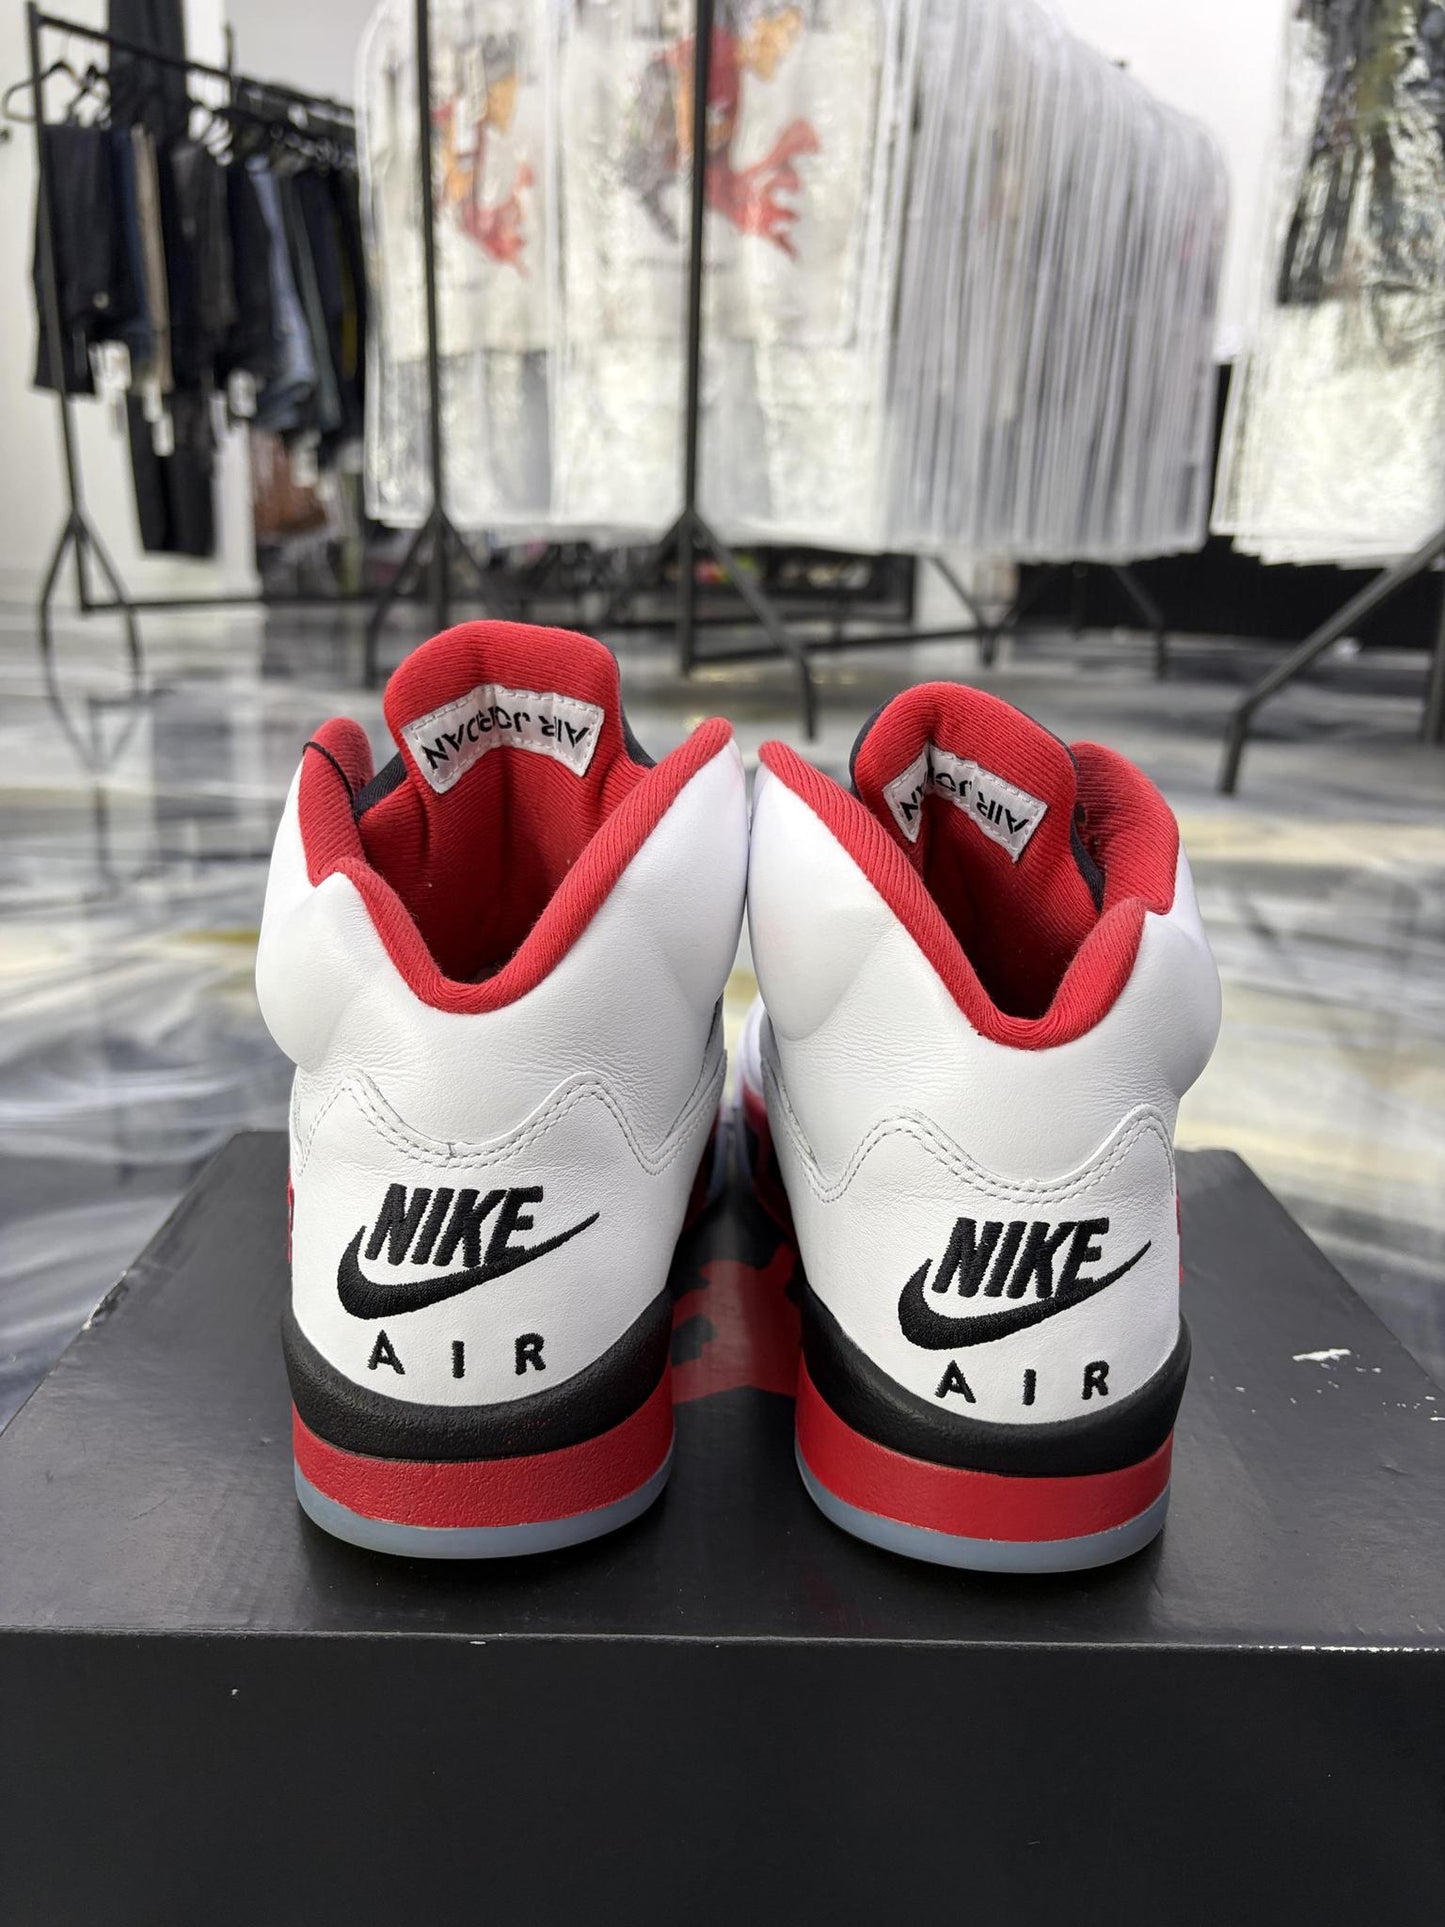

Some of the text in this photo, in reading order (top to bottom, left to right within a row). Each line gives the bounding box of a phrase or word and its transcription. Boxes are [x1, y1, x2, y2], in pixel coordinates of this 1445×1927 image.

[421, 705, 590, 770] AIR JORDAN
[976, 791, 1029, 834] AIR
[364, 1183, 543, 1268] NIKE
[931, 1217, 1110, 1299] NIKE
[367, 1329, 546, 1378] AIR
[934, 1360, 1110, 1405] AIR
